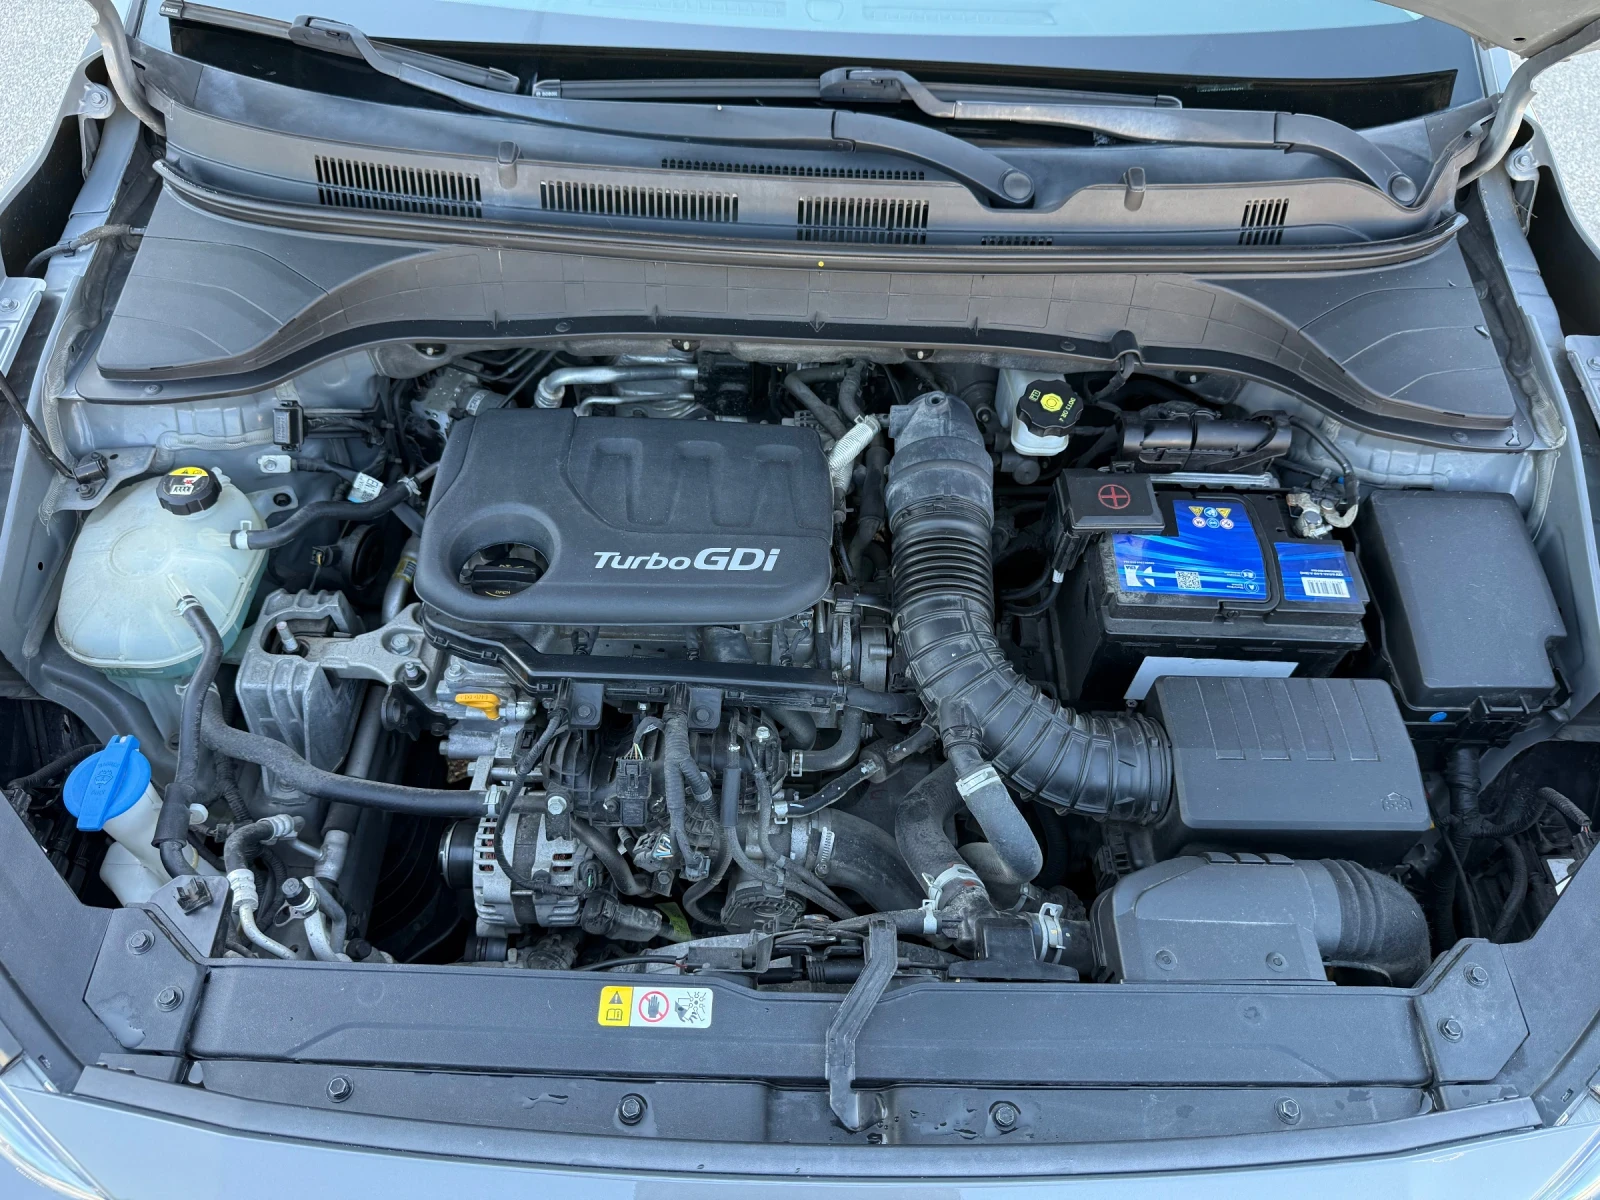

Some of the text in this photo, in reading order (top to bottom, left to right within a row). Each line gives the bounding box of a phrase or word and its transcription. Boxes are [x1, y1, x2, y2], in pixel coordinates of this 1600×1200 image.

[1065, 397, 1076, 410] DOT3
[593, 547, 781, 571] Turbo GDi
